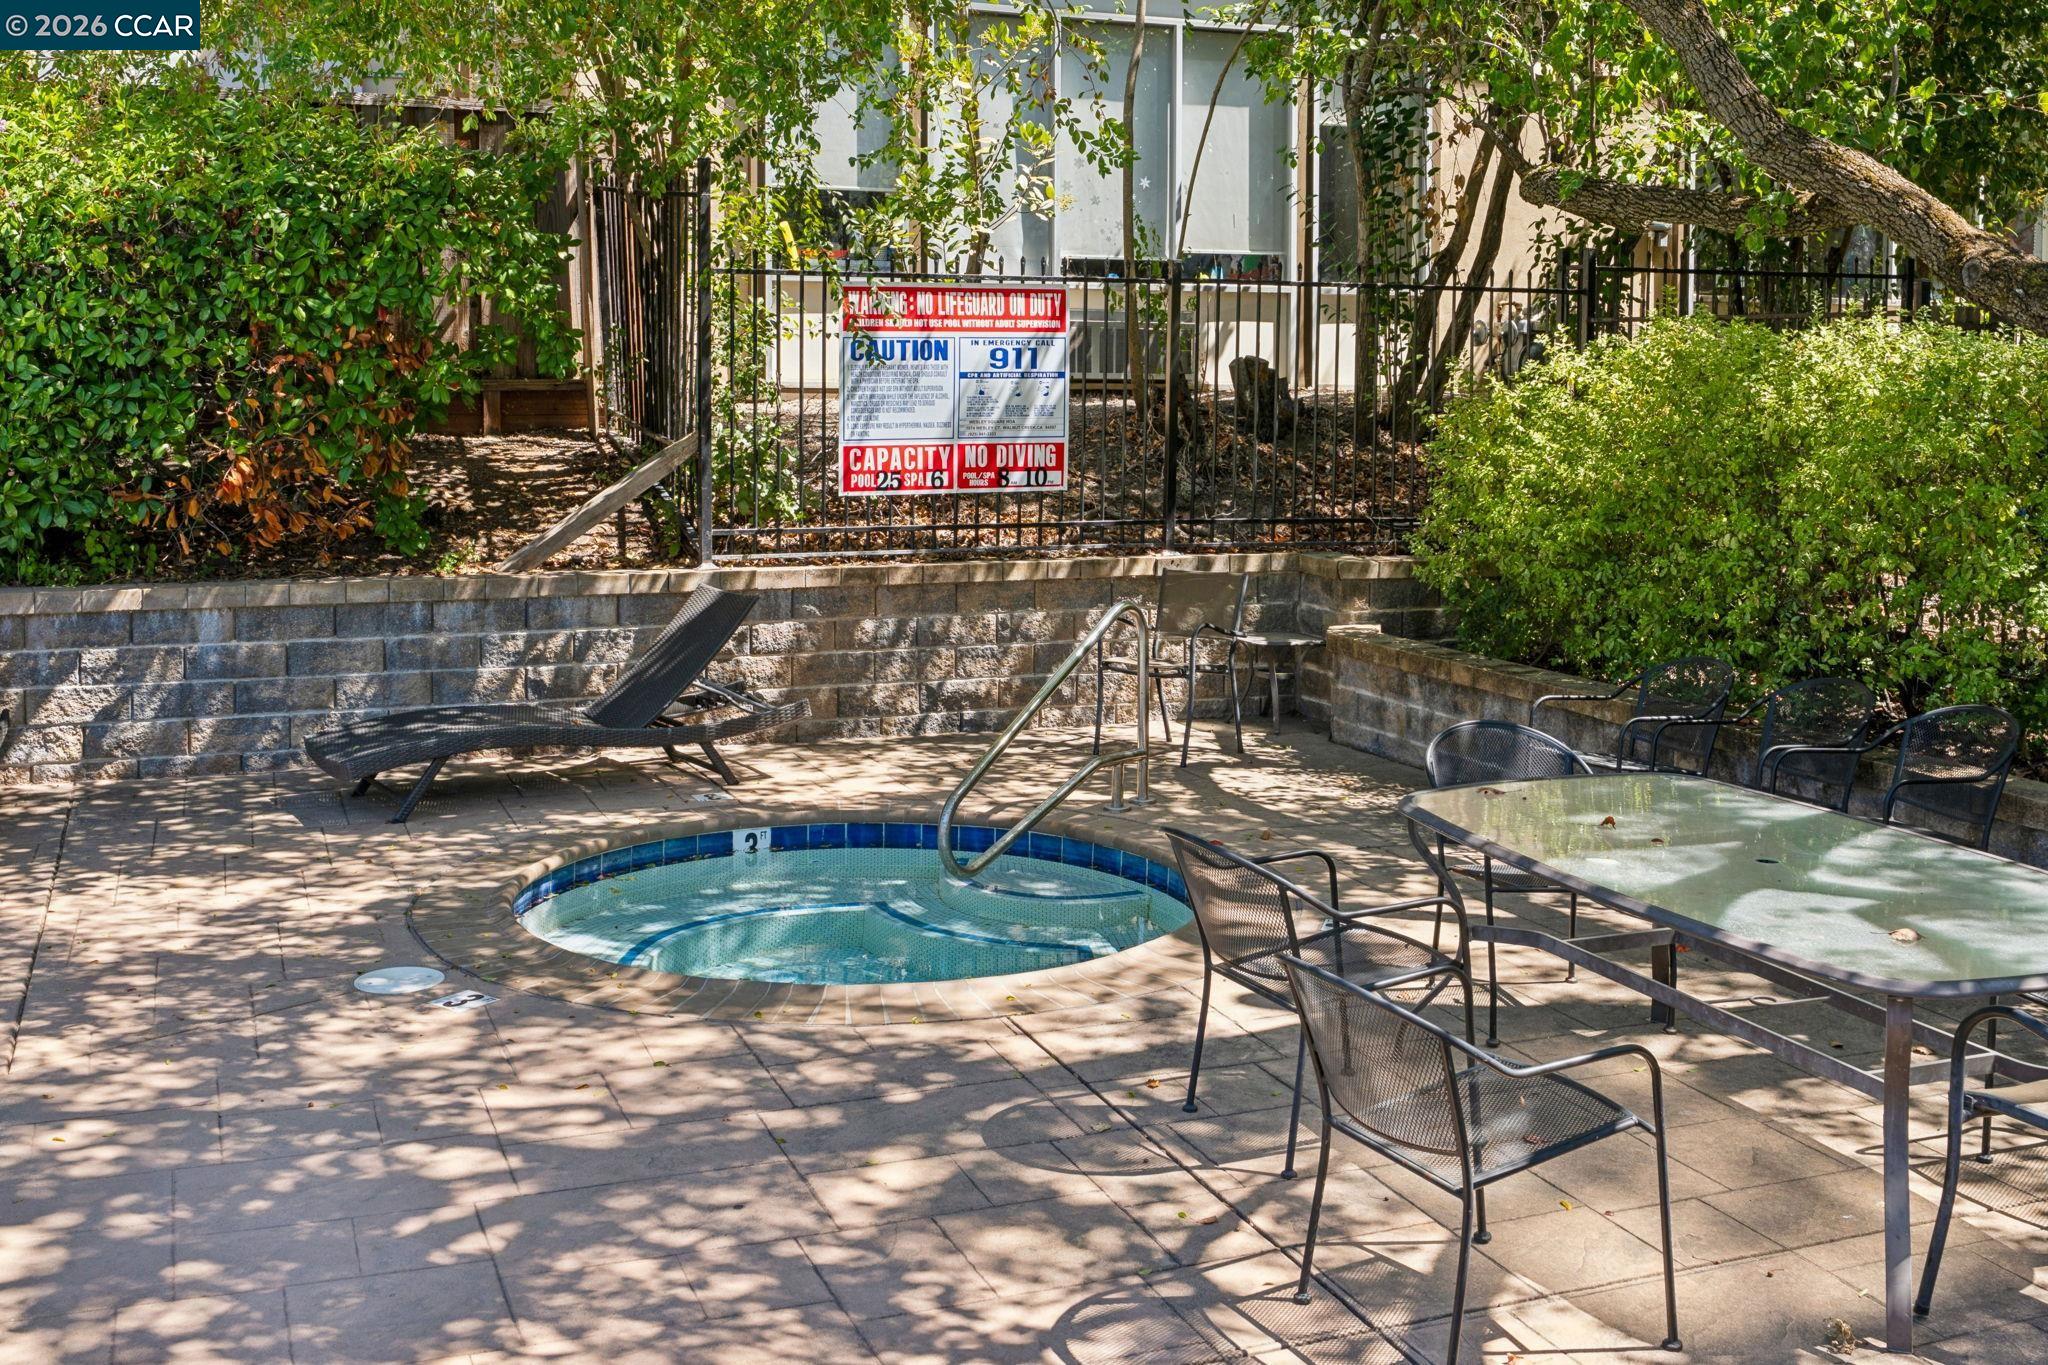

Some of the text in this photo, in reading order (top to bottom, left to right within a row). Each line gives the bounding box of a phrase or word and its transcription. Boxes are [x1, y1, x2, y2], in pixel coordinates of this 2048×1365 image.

[916, 291, 933, 315] NO
[937, 291, 1005, 316] LIFEGUARD
[1009, 292, 1026, 316] ON
[1029, 293, 1062, 317] DUTY
[914, 318, 928, 327] NOT
[929, 319, 943, 327] USE
[943, 319, 961, 327] POOL
[962, 319, 994, 328] WITHOUT
[994, 319, 1015, 328] ADULT
[1016, 319, 1061, 329] SUPERVISION
[850, 339, 949, 361] CAUTION
[1035, 339, 1056, 347] CALL
[989, 347, 1038, 370] 911
[849, 446, 951, 472] CAPACITY
[964, 444, 1057, 468] NO DIVING
[850, 469, 945, 491] POOL 25 SPA 6
[997, 467, 1010, 487] 8
[1024, 467, 1048, 487] 10
